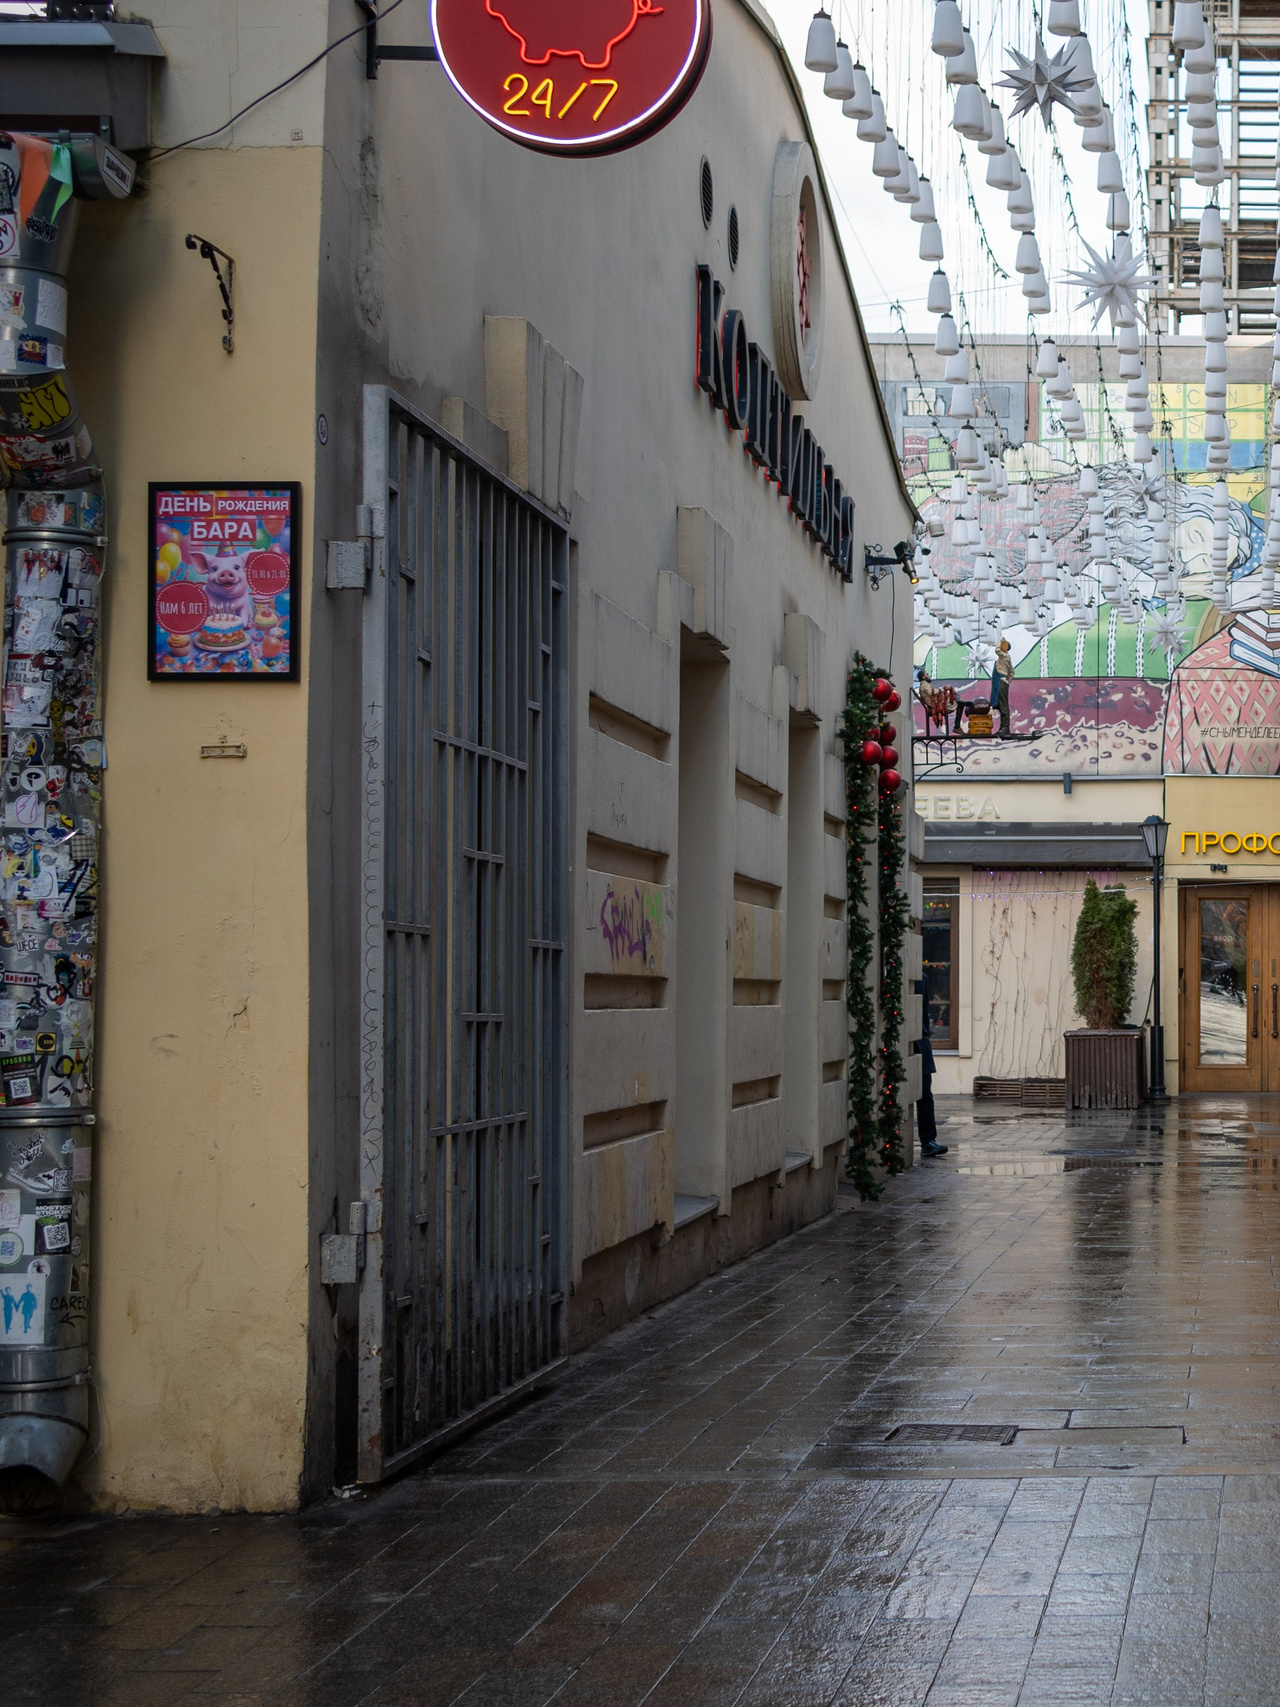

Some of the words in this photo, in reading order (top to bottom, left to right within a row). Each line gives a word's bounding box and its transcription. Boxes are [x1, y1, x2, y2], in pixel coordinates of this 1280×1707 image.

[502, 73, 619, 122] 24/7
[159, 496, 211, 514] ДЕНЬ
[217, 499, 289, 513] РОЖДЕНИЯ
[192, 521, 254, 539] БАРА
[160, 602, 179, 616] НАМ
[180, 602, 186, 614] 6
[187, 602, 203, 615] ЛЕТ
